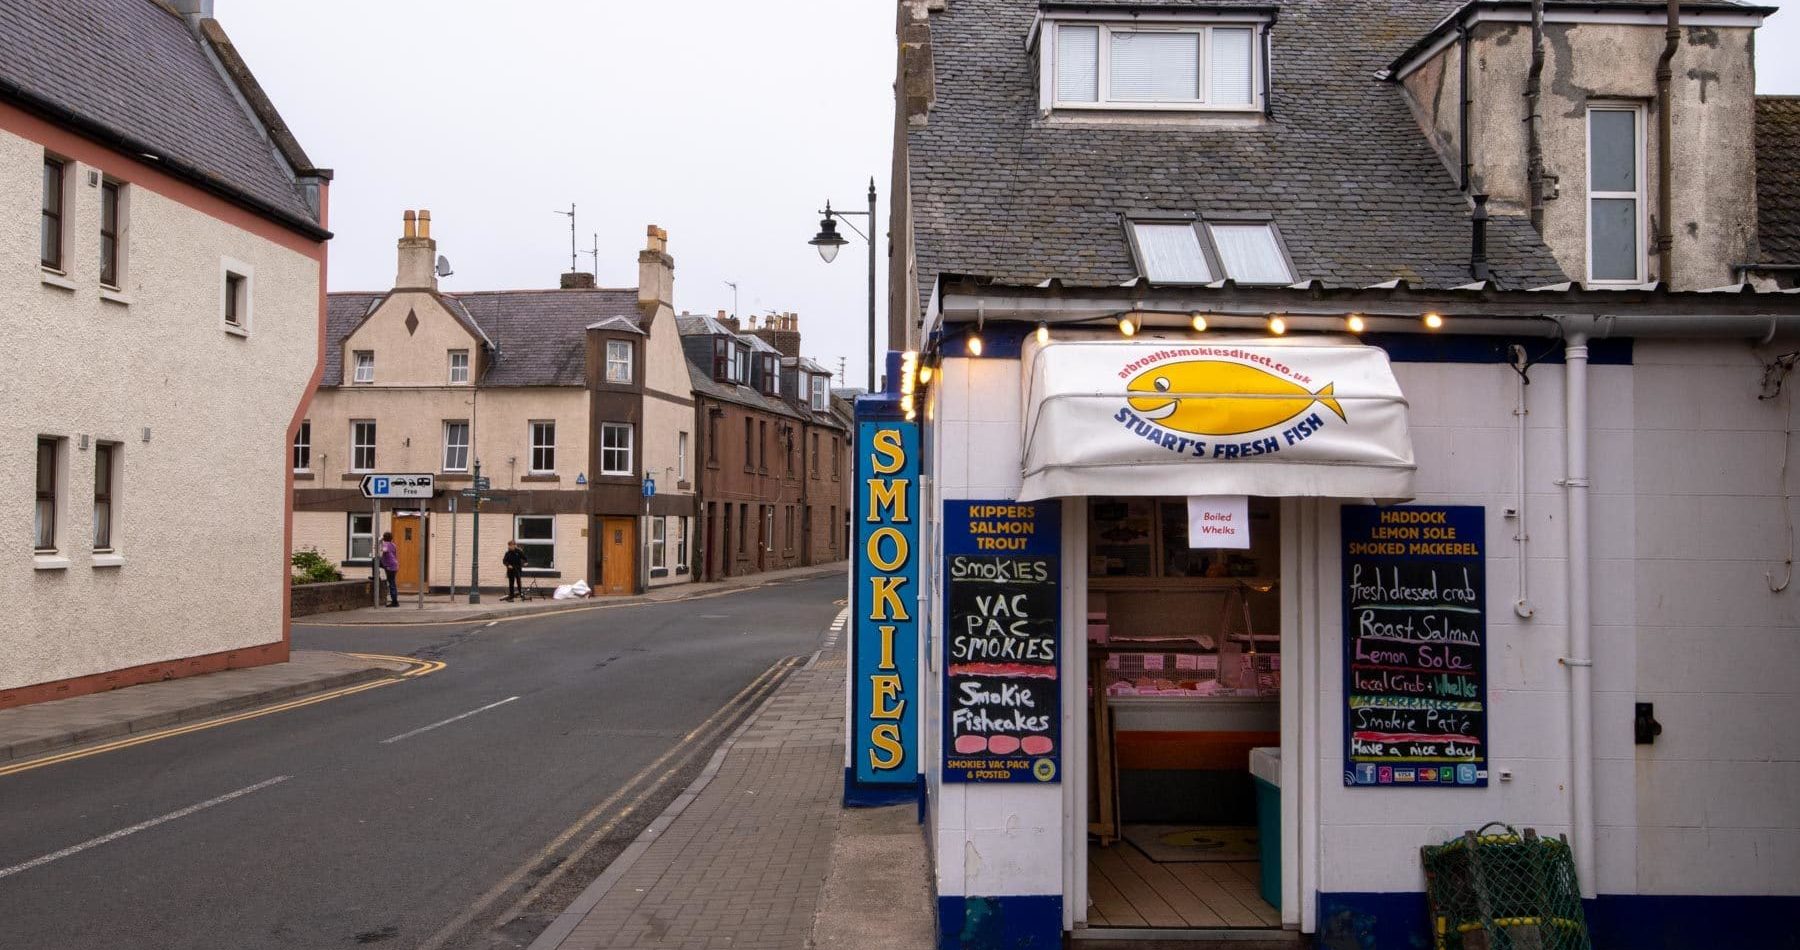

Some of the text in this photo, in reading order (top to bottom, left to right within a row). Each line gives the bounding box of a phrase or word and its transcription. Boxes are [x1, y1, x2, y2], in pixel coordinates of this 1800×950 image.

[1118, 347, 1313, 385] arbroathsmokiesdirect.co.uk
[1114, 406, 1325, 460] STUART'S FRESH FISH
[377, 479, 387, 493] P
[403, 487, 418, 495] Free
[969, 505, 1035, 518] KIPPERS
[1204, 512, 1232, 521] Boiled
[1380, 511, 1447, 524] HADDOCK
[969, 521, 1035, 534] SALMON
[1202, 526, 1236, 535] Whelks
[1371, 527, 1457, 539] LEMON SOLE
[976, 537, 1028, 550] TROUT
[1348, 542, 1479, 555] SMOKED MACKEREL
[1349, 563, 1476, 603] fresh dressed crab
[867, 429, 909, 770] SMOKIES
[975, 593, 1029, 618] VAC
[966, 615, 1031, 637] PAC
[1359, 609, 1414, 640] Roast
[1355, 638, 1473, 669] Lemon Sole
[959, 682, 1035, 708] Smokie
[952, 707, 1050, 738] Fishcakes
[1356, 707, 1417, 732] Smokie
[1351, 738, 1476, 762] Have a nice day
[947, 760, 1030, 769] SMOKIES VAC PACK
[975, 770, 1011, 779] POSTED
